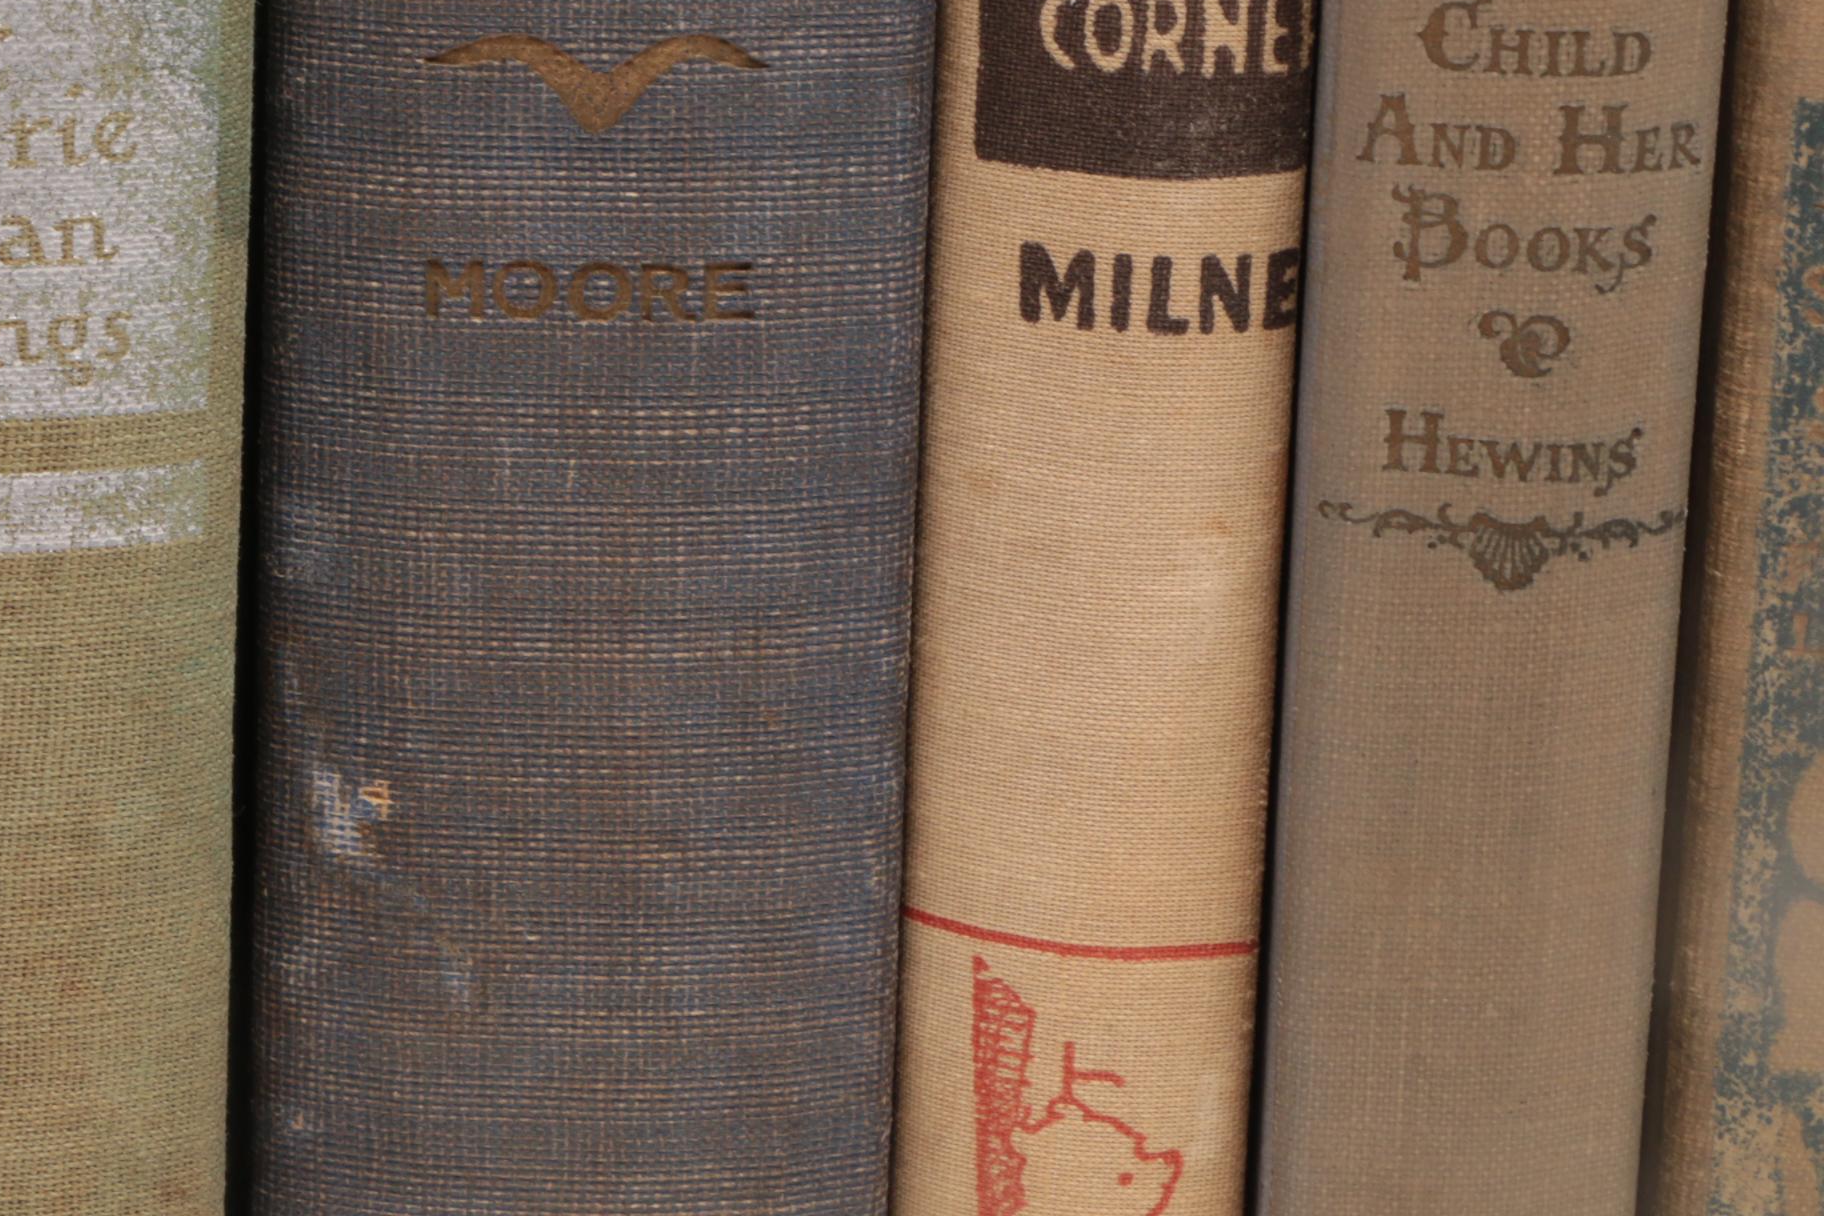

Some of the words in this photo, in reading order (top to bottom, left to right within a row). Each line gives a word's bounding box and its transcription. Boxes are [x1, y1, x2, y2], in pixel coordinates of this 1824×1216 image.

[1356, 93, 1517, 172] AND
[1553, 103, 1702, 176] HER
[1392, 184, 1656, 295] BOOKS
[424, 258, 756, 323] MOORE
[1382, 408, 1644, 498] HEWINS
